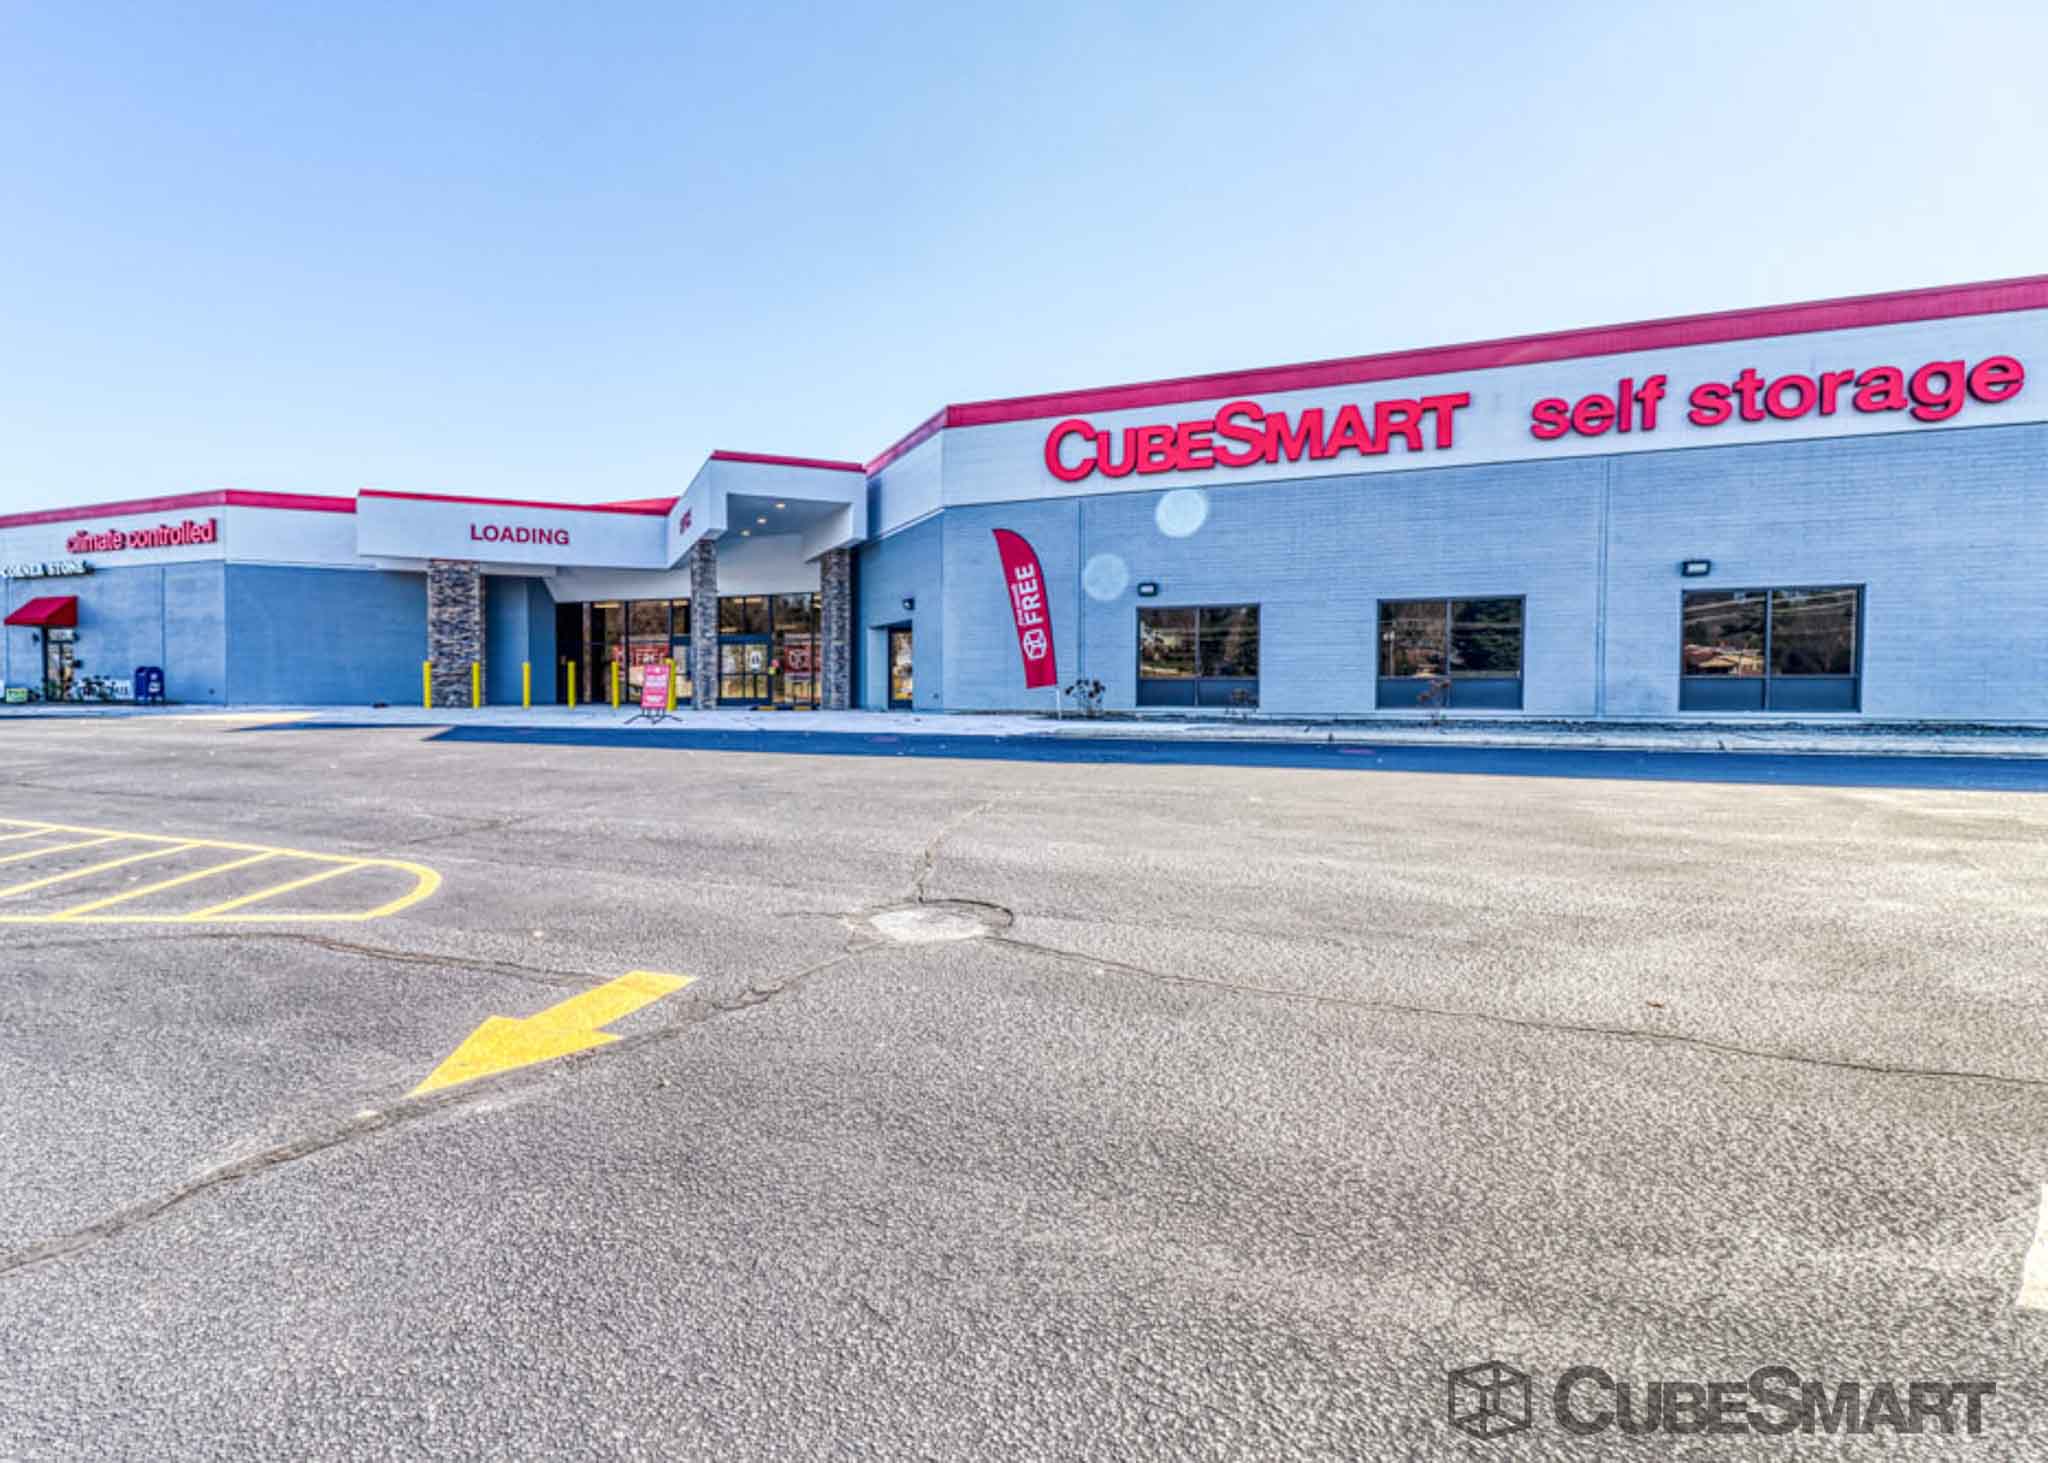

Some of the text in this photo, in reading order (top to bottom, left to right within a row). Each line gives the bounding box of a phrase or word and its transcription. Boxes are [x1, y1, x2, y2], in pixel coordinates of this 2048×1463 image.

[1531, 355, 2025, 440] self storage
[66, 518, 217, 554] climate controlled
[470, 523, 570, 546] LOADING
[1014, 563, 1043, 625] FREE
